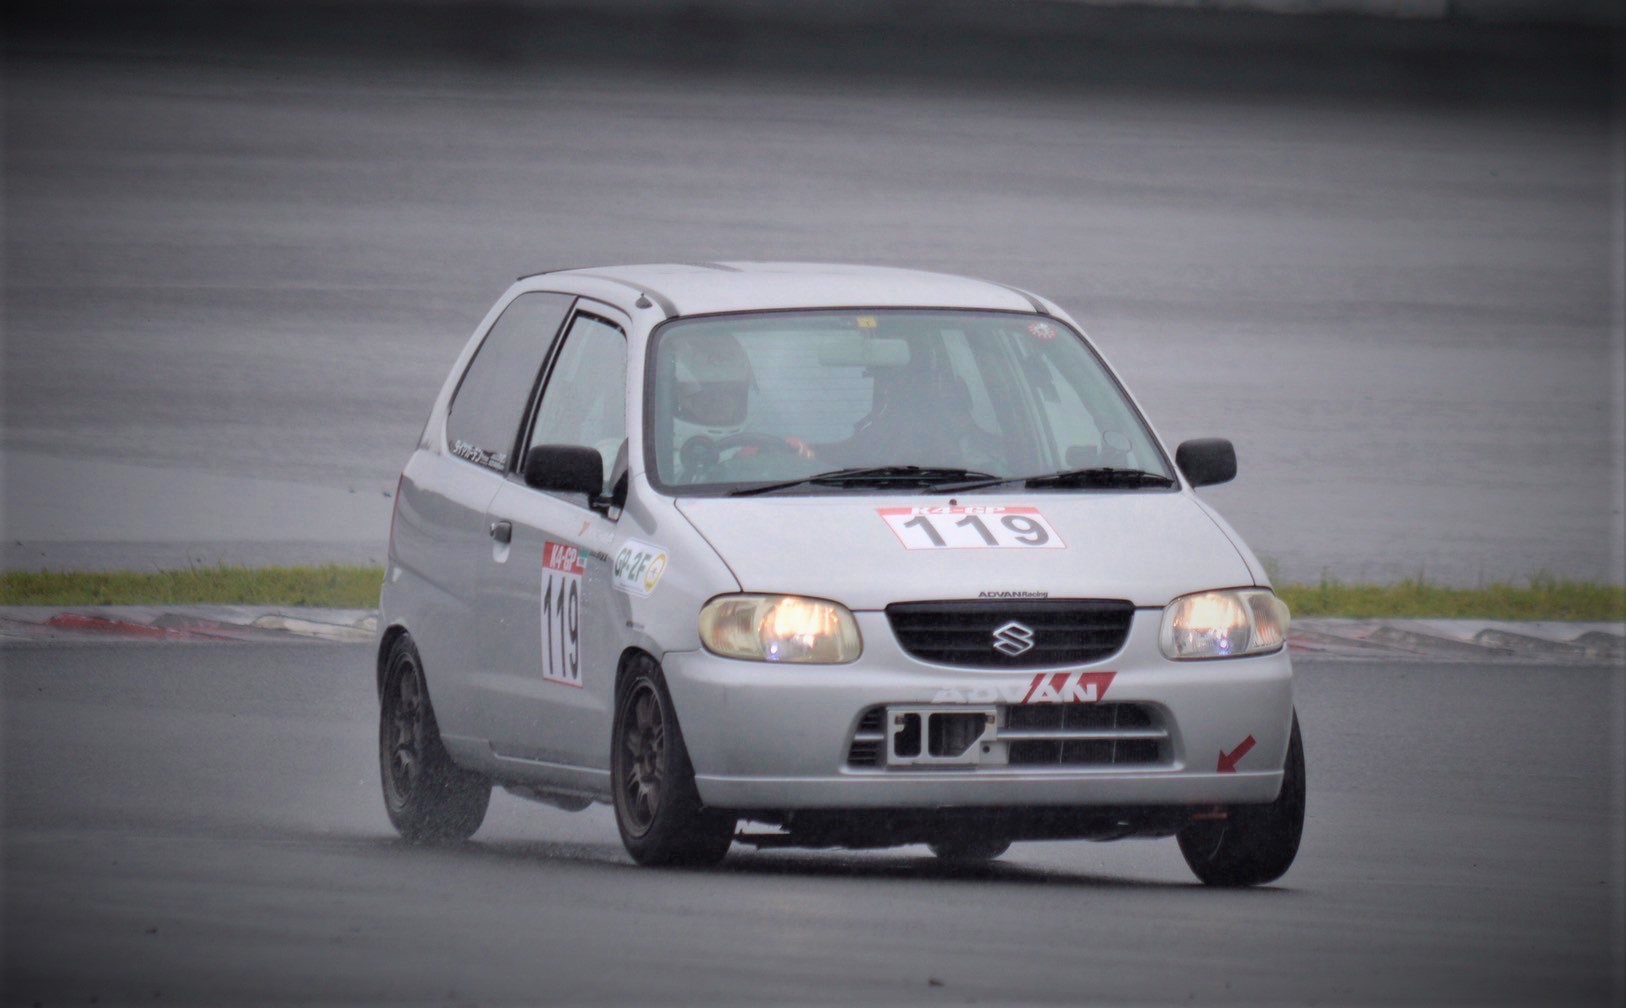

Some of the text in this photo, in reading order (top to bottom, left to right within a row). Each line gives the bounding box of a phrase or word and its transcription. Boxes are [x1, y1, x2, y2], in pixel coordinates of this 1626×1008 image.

[904, 515, 1049, 546] 119
[549, 544, 578, 572] K4-GP
[614, 547, 652, 582] GP-2F
[544, 574, 579, 680] 119
[931, 679, 1100, 704] ADVAN
